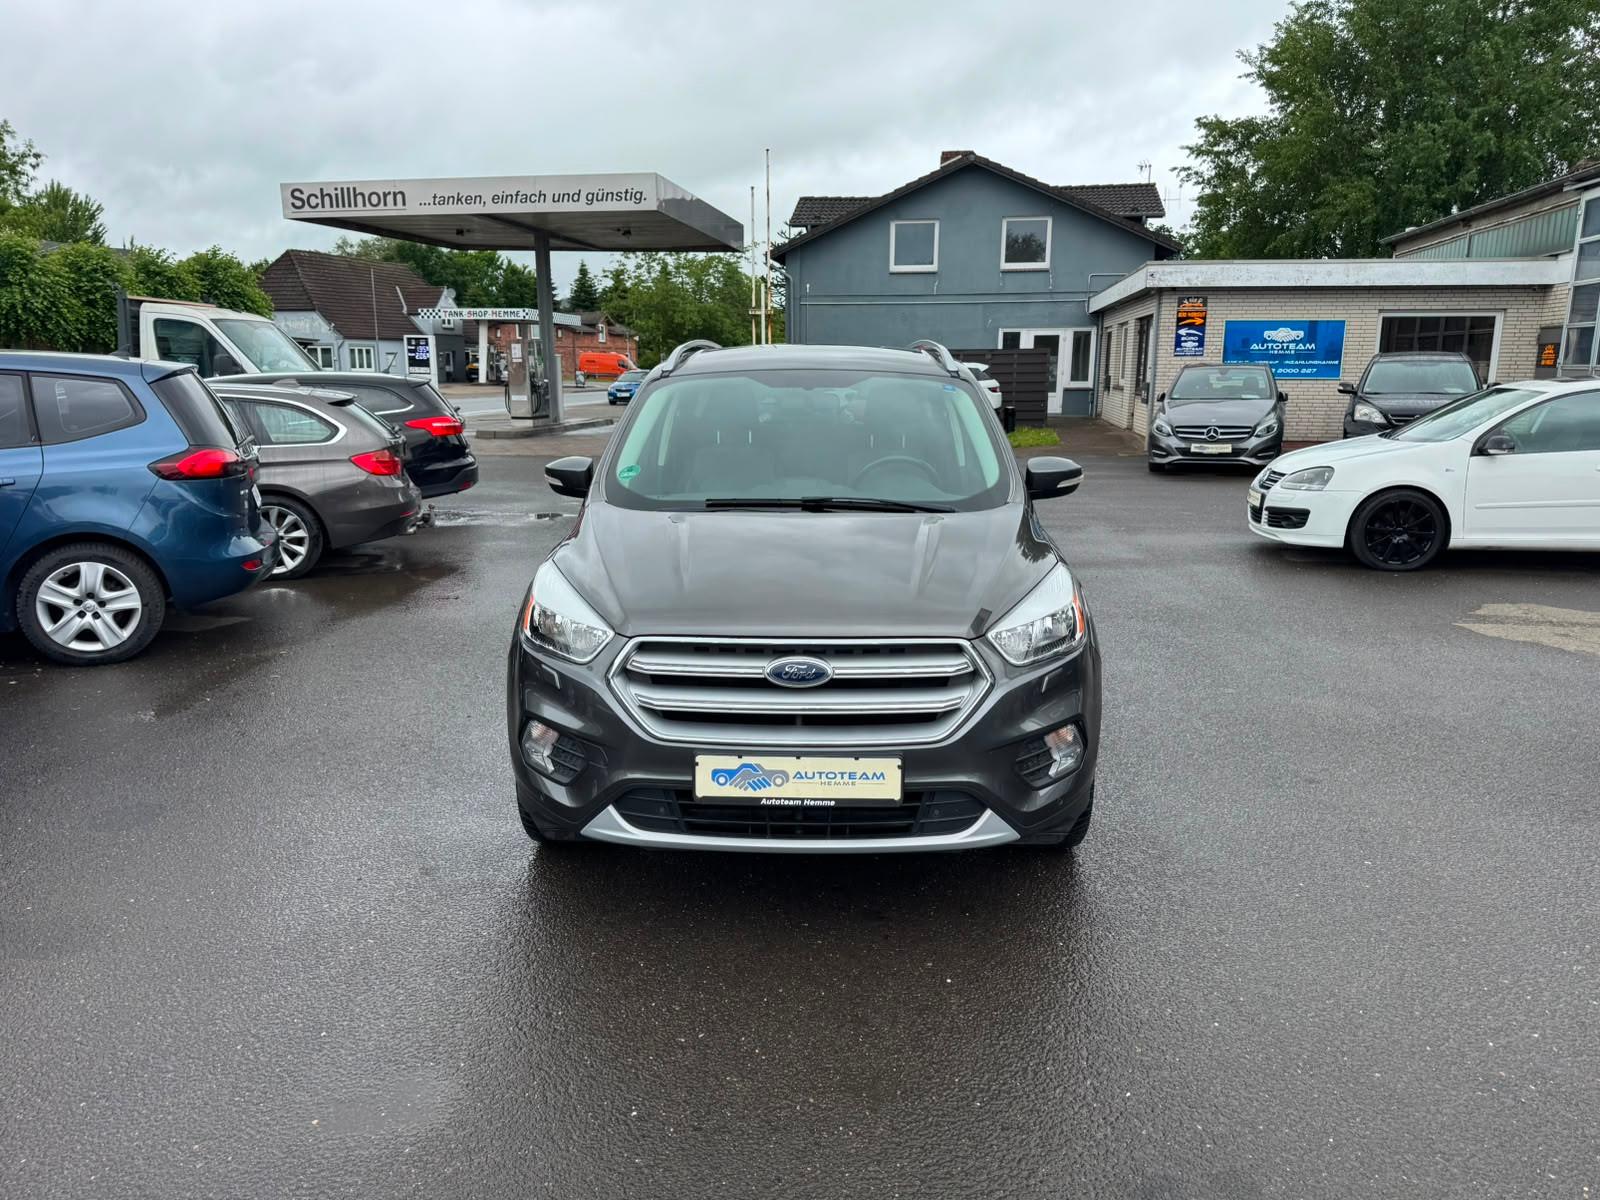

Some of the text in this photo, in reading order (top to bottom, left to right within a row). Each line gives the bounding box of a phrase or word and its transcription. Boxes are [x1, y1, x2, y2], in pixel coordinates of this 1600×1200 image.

[290, 187, 407, 210] Schillhorn
[491, 190, 547, 205] einfach
[552, 189, 581, 203] und
[585, 187, 648, 206] günstig.
[781, 664, 816, 680] Ford
[792, 771, 886, 781] AUTOTEAM
[760, 798, 836, 807] Autoteam Hemme
